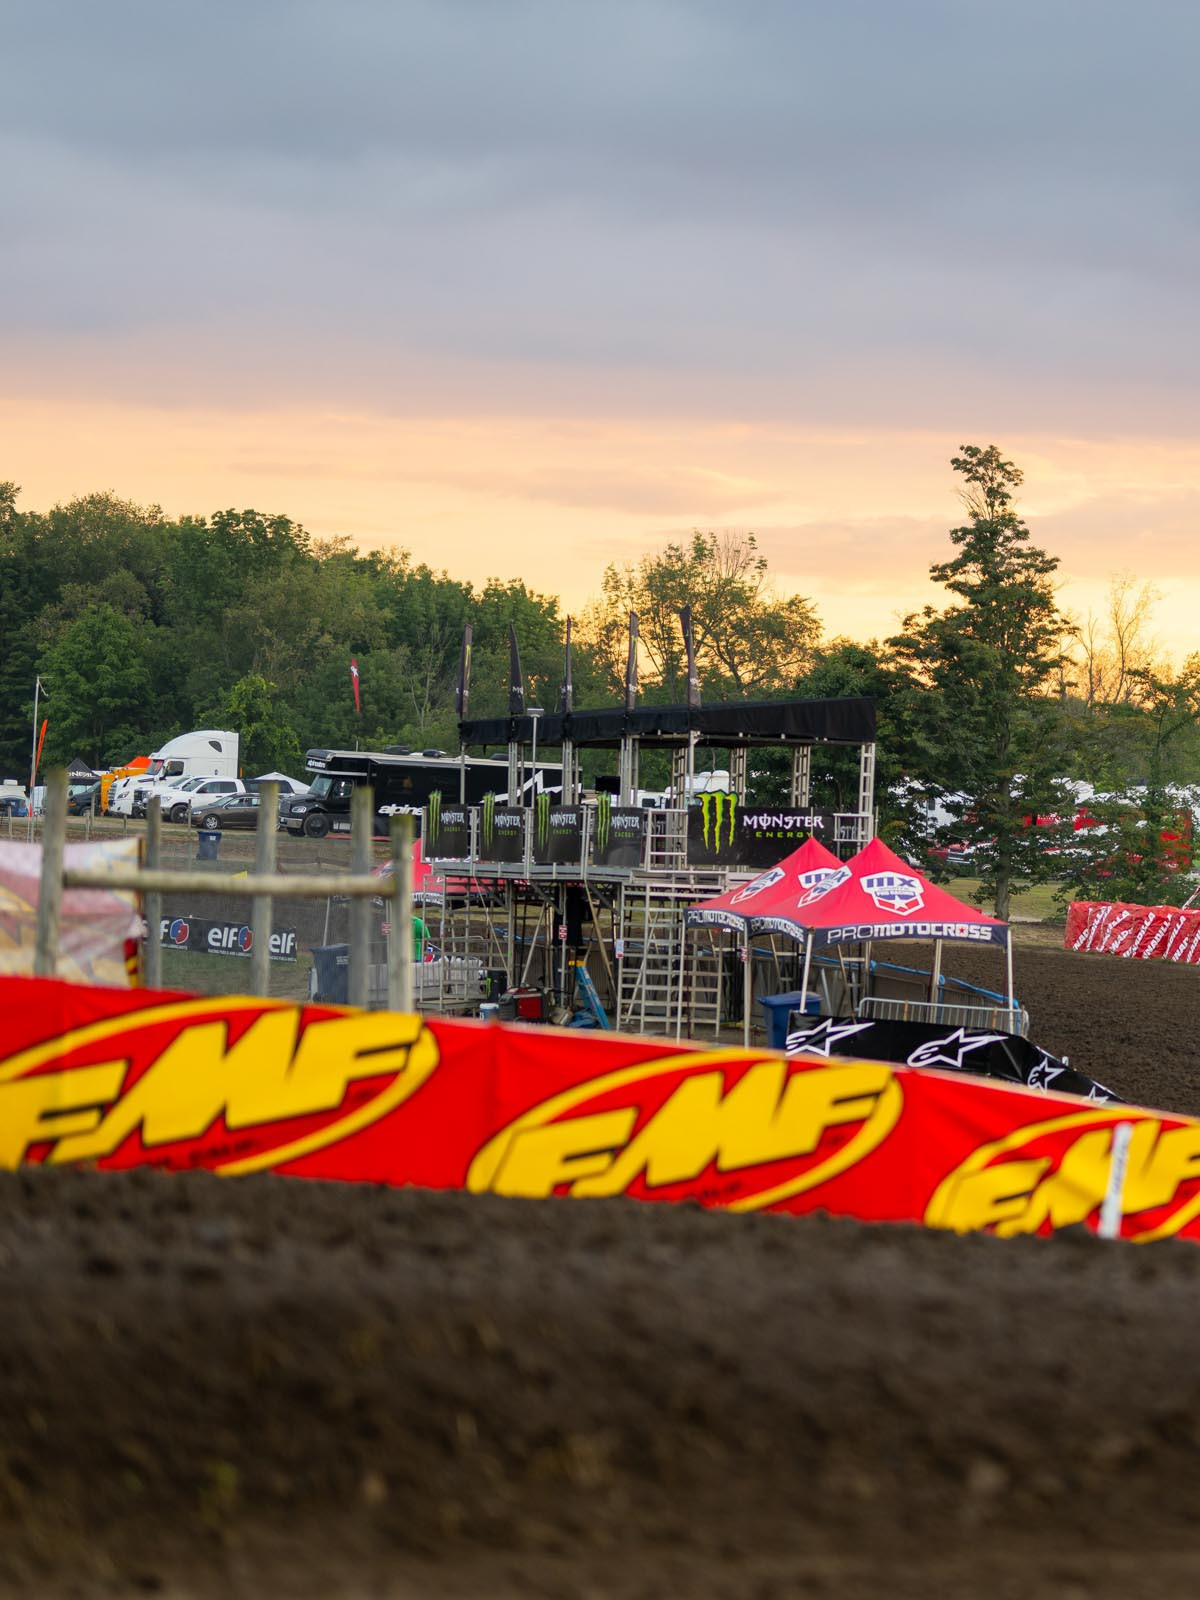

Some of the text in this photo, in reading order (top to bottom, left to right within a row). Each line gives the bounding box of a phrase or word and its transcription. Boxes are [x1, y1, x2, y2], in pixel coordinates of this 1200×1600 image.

[378, 803, 423, 817] alpine
[550, 811, 577, 827] MONSTER
[611, 814, 640, 830] MONSTER
[743, 813, 825, 830] MONSTER
[207, 927, 239, 949] elf
[269, 933, 296, 955] elf
[0, 1004, 423, 1173] FMF
[491, 1060, 892, 1199] FMF
